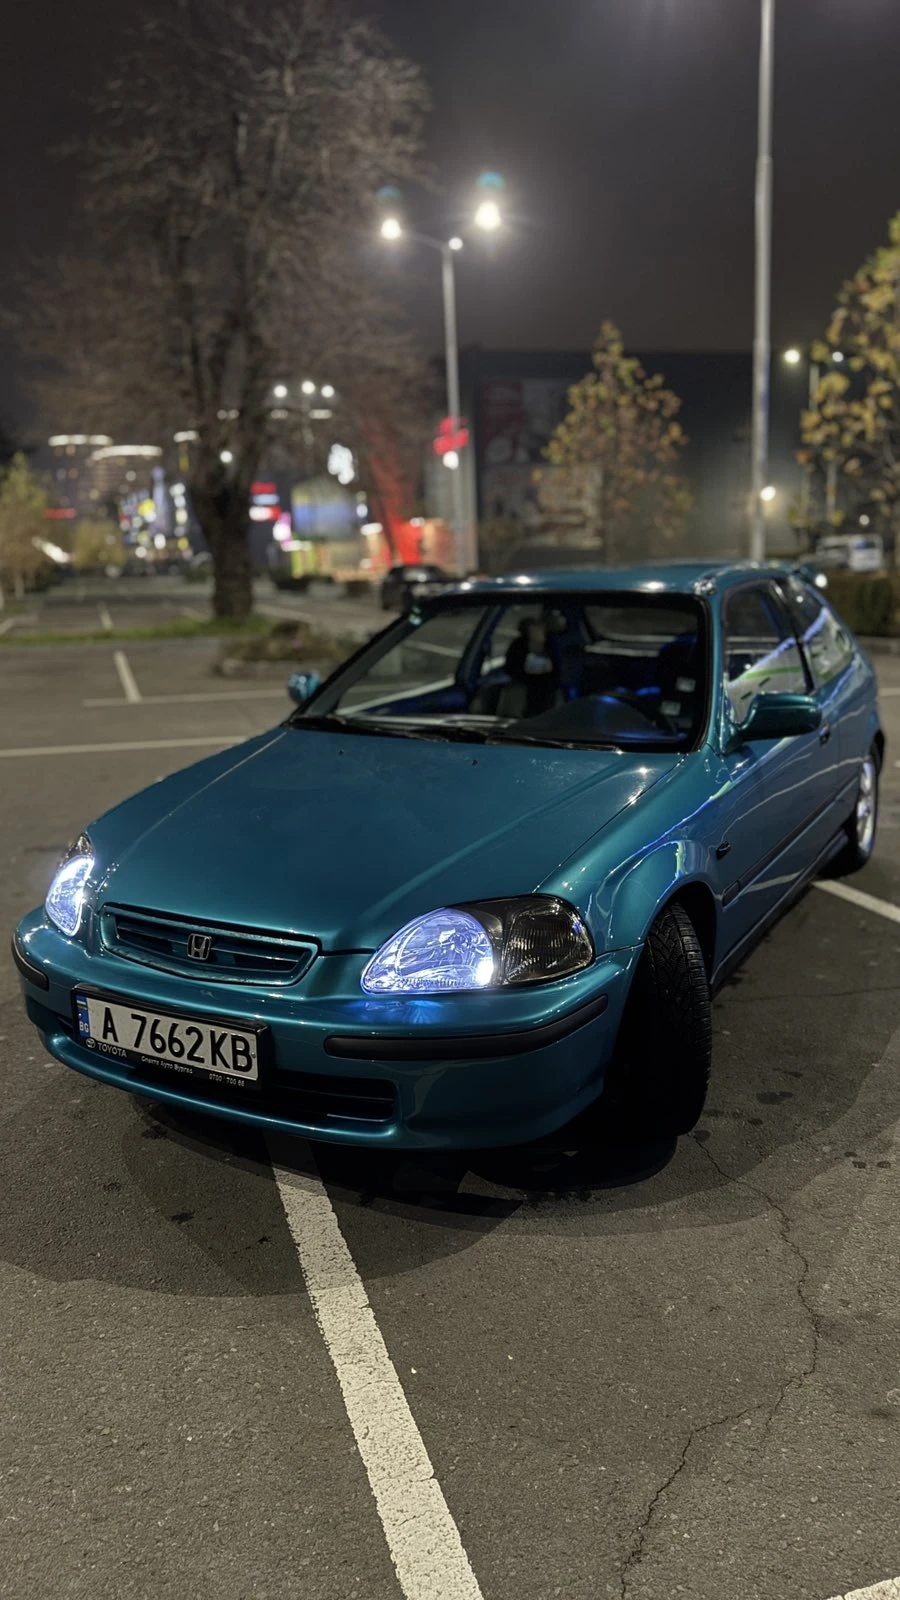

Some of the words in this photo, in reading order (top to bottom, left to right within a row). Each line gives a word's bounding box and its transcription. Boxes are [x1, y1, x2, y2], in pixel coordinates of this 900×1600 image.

[79, 1020, 90, 1033] BG
[102, 1006, 119, 1043] A
[97, 1042, 127, 1058] TOYOTA
